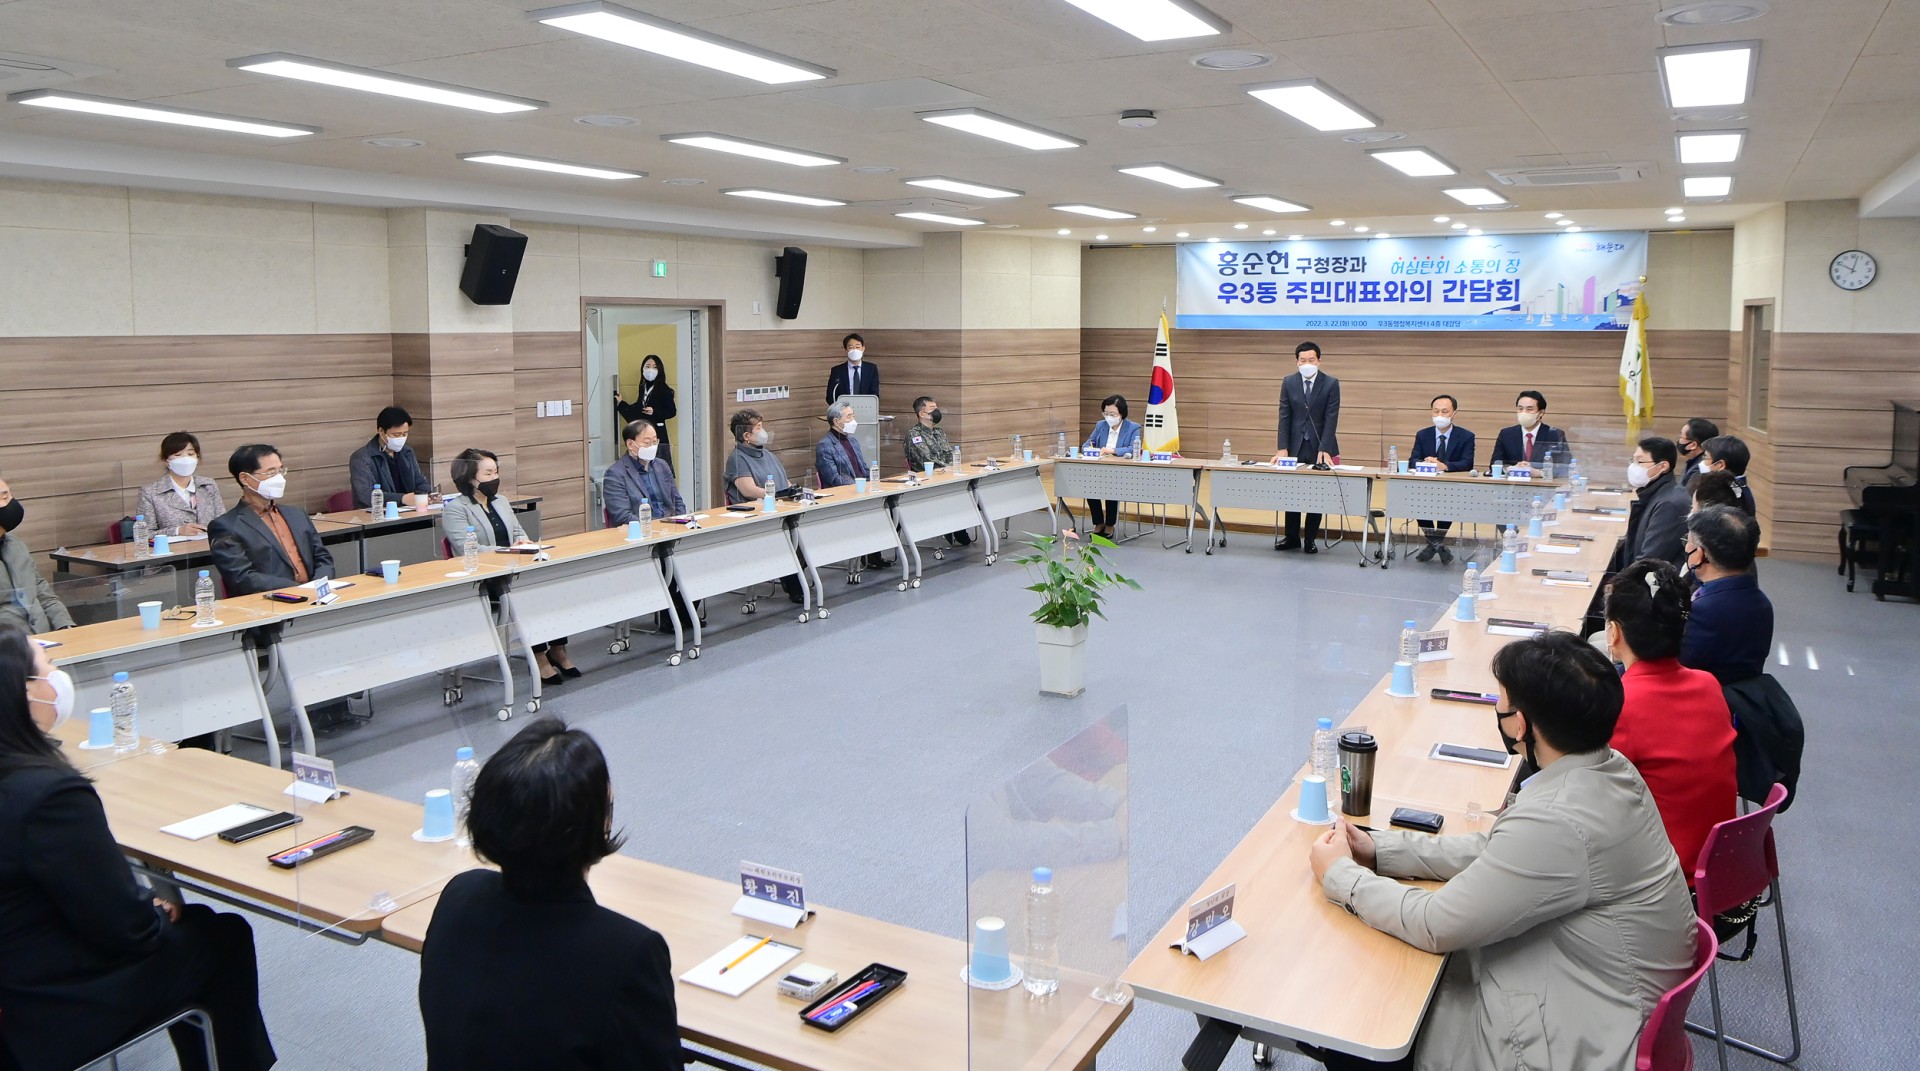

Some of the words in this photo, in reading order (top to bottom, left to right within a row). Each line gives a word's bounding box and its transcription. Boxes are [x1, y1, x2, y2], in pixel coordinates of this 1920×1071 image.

[1217, 250, 1289, 276] 홍순헌
[1296, 256, 1367, 274] 구청장과
[1391, 258, 1450, 275] 허심탄회
[1454, 259, 1501, 275] 소통의
[1505, 258, 1521, 274] 장
[1217, 281, 1278, 304] 우3동
[1286, 280, 1432, 304] 주민대표와의
[1442, 279, 1521, 303] 간담회
[744, 878, 801, 907] 황명진
[1188, 904, 1230, 937] 강민오
